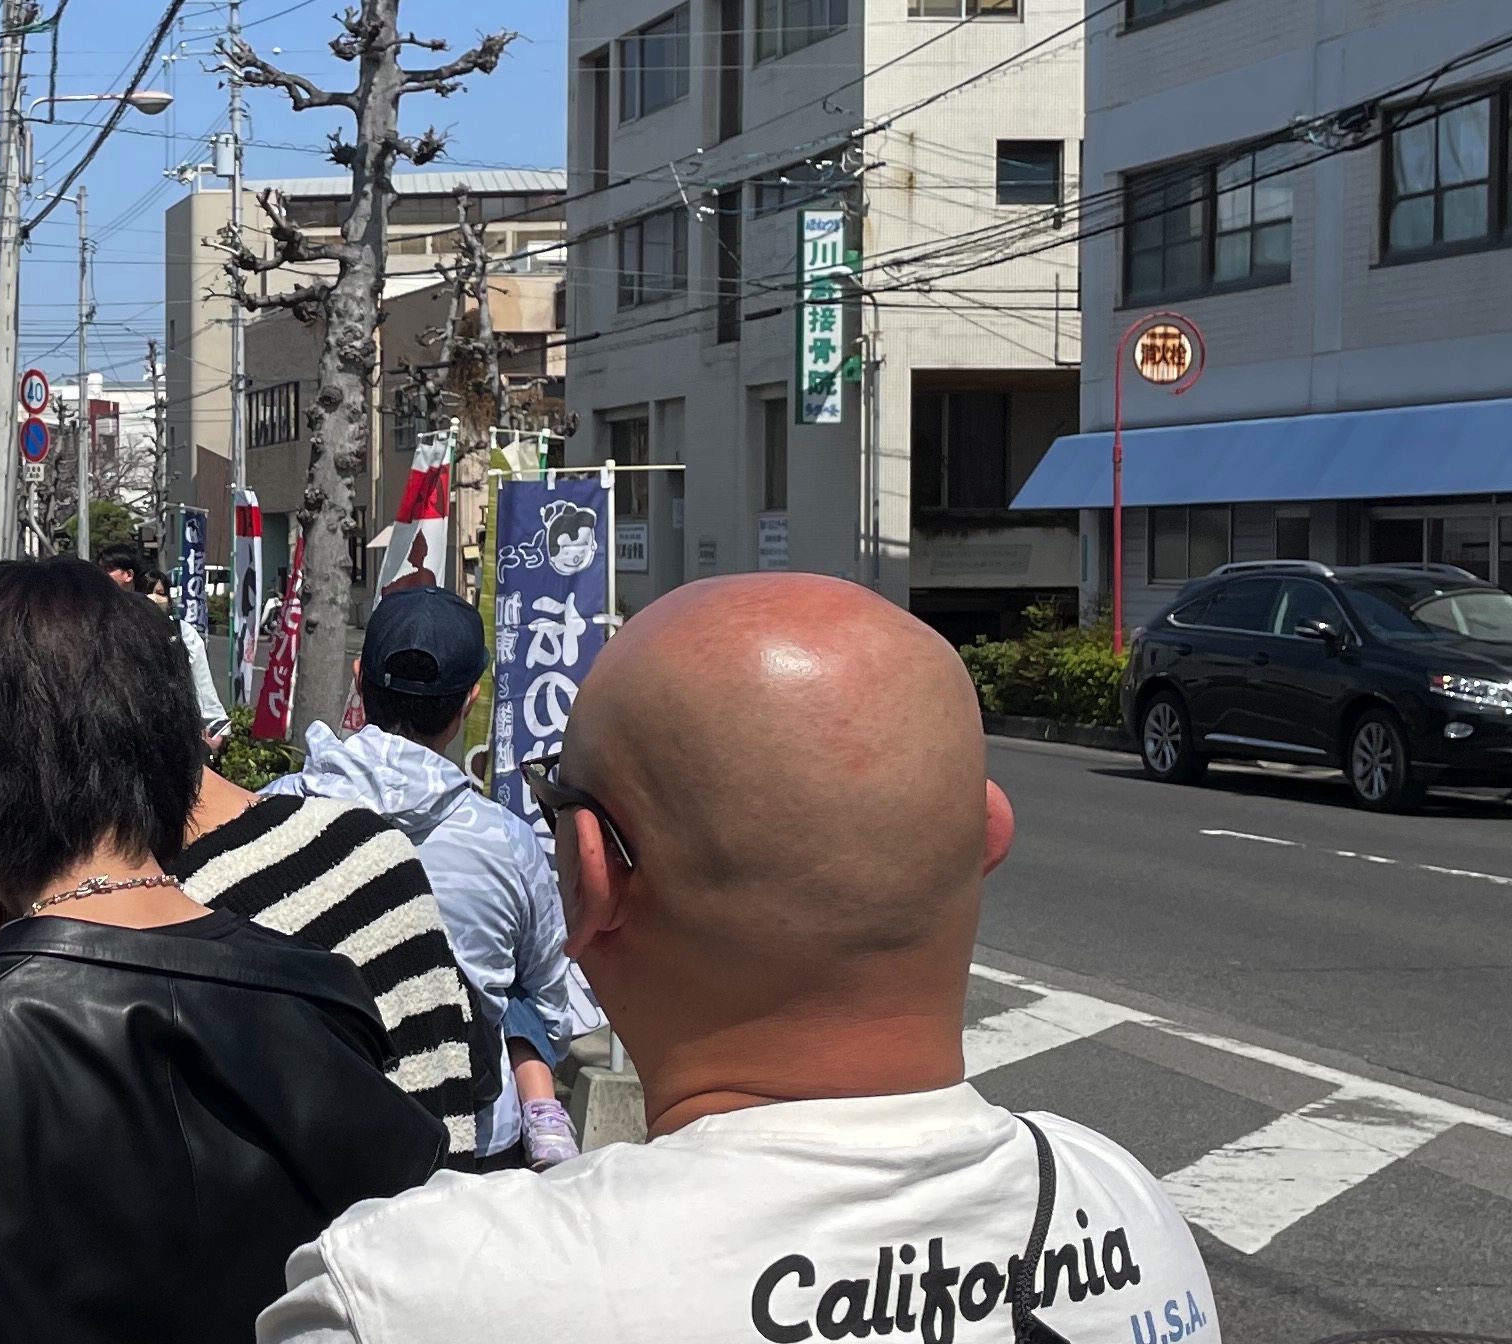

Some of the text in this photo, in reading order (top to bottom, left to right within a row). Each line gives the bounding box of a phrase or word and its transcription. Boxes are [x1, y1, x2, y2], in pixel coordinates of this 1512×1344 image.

[1140, 343, 1187, 367] 消火栓
[27, 382, 43, 402] 40
